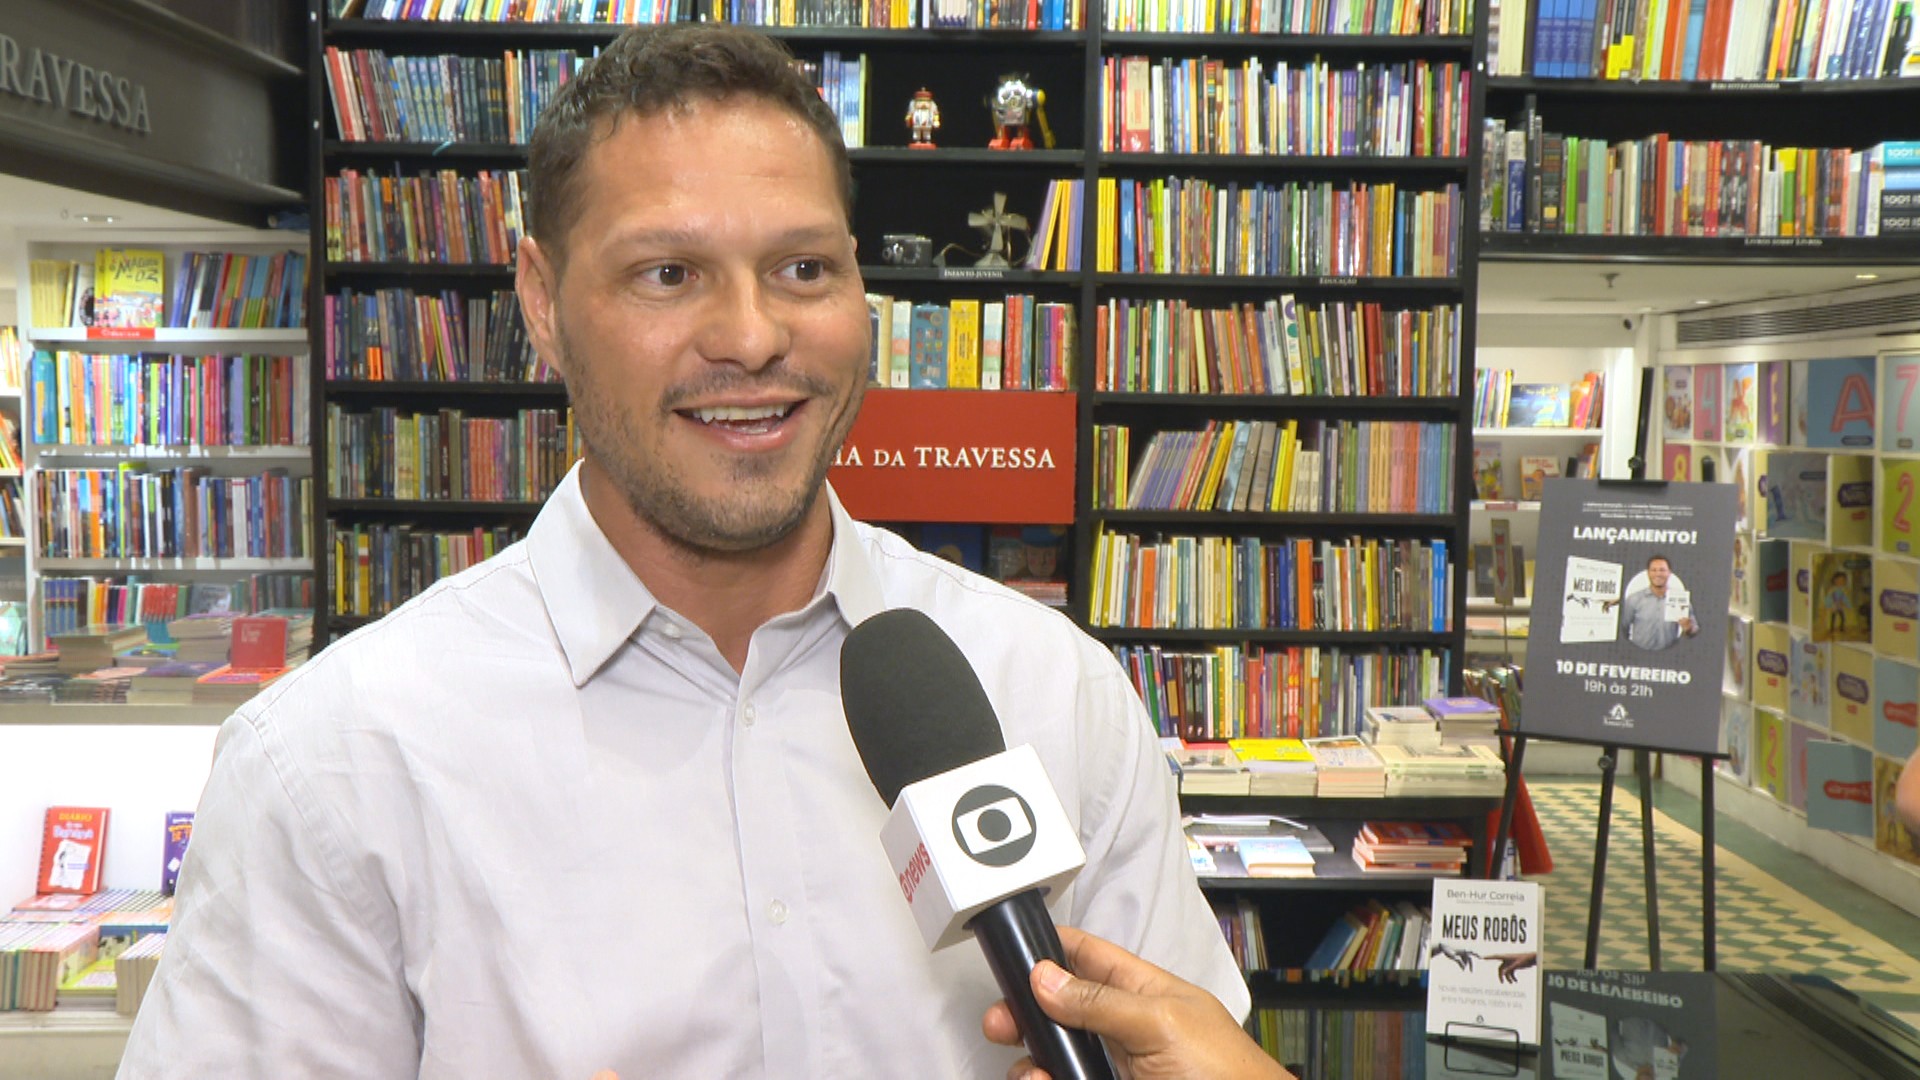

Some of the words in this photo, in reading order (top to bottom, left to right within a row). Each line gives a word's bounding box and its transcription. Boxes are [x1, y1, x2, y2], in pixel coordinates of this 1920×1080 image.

[831, 446, 863, 467] IA
[873, 449, 906, 467] DA
[914, 446, 1056, 468] TRAVESSA
[1573, 525, 1698, 545] LANÇAMENTO!
[1573, 578, 1594, 592] MEUS
[1556, 660, 1574, 675] 10
[1576, 662, 1598, 676] DE
[1600, 664, 1692, 685] FEVEREIRO
[1584, 679, 1606, 693] 19h
[1609, 681, 1627, 695] às
[1631, 683, 1653, 697] 21h
[1447, 889, 1487, 899] Ben-Hur
[1489, 891, 1525, 902] Correia
[1442, 913, 1478, 940] MEUS
[1484, 913, 1527, 944] ROBÔS
